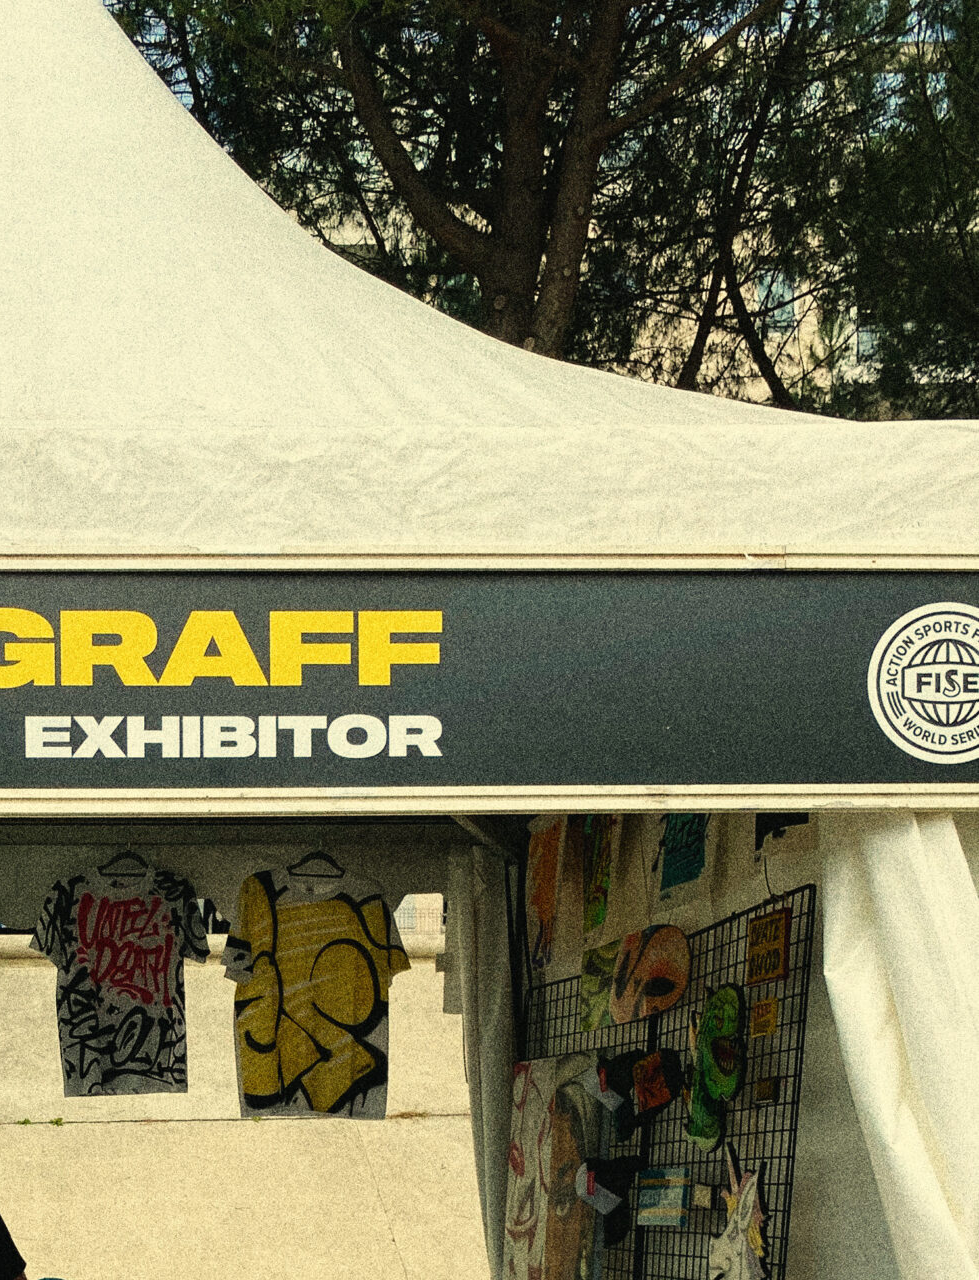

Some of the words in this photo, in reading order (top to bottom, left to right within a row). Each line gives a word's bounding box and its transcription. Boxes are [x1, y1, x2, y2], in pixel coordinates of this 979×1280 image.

[886, 636, 915, 686] ACTION
[914, 620, 971, 641] SPORTS
[916, 669, 979, 698] FISE
[25, 714, 442, 758] EXHIBITOR
[903, 717, 947, 745] WORLD
[951, 725, 979, 745] SERI
